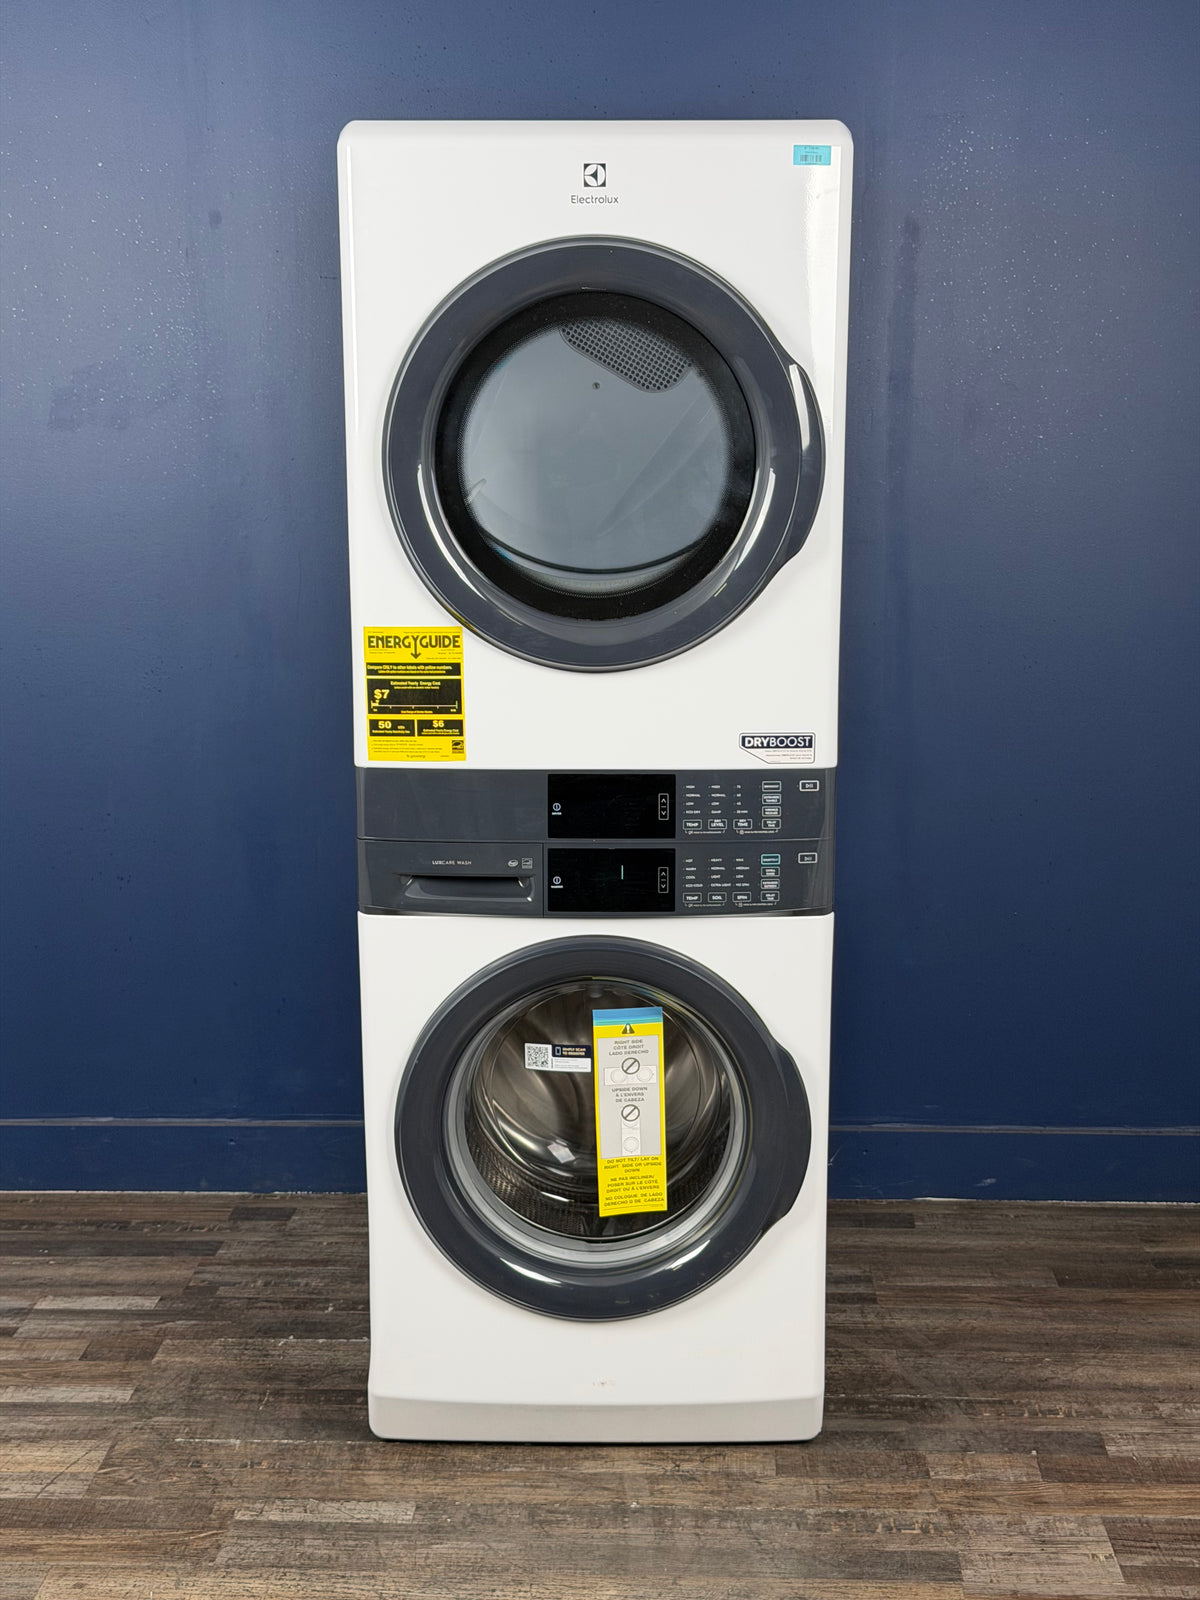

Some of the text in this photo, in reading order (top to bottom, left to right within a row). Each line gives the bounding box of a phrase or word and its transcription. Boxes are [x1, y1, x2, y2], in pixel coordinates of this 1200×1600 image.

[571, 195, 619, 204] Electrolux
[368, 635, 460, 648] ENERGYGUIDE
[374, 689, 390, 699] $7
[378, 721, 391, 729] 50
[432, 720, 445, 728] $6
[744, 737, 811, 747] DRYBOOST
